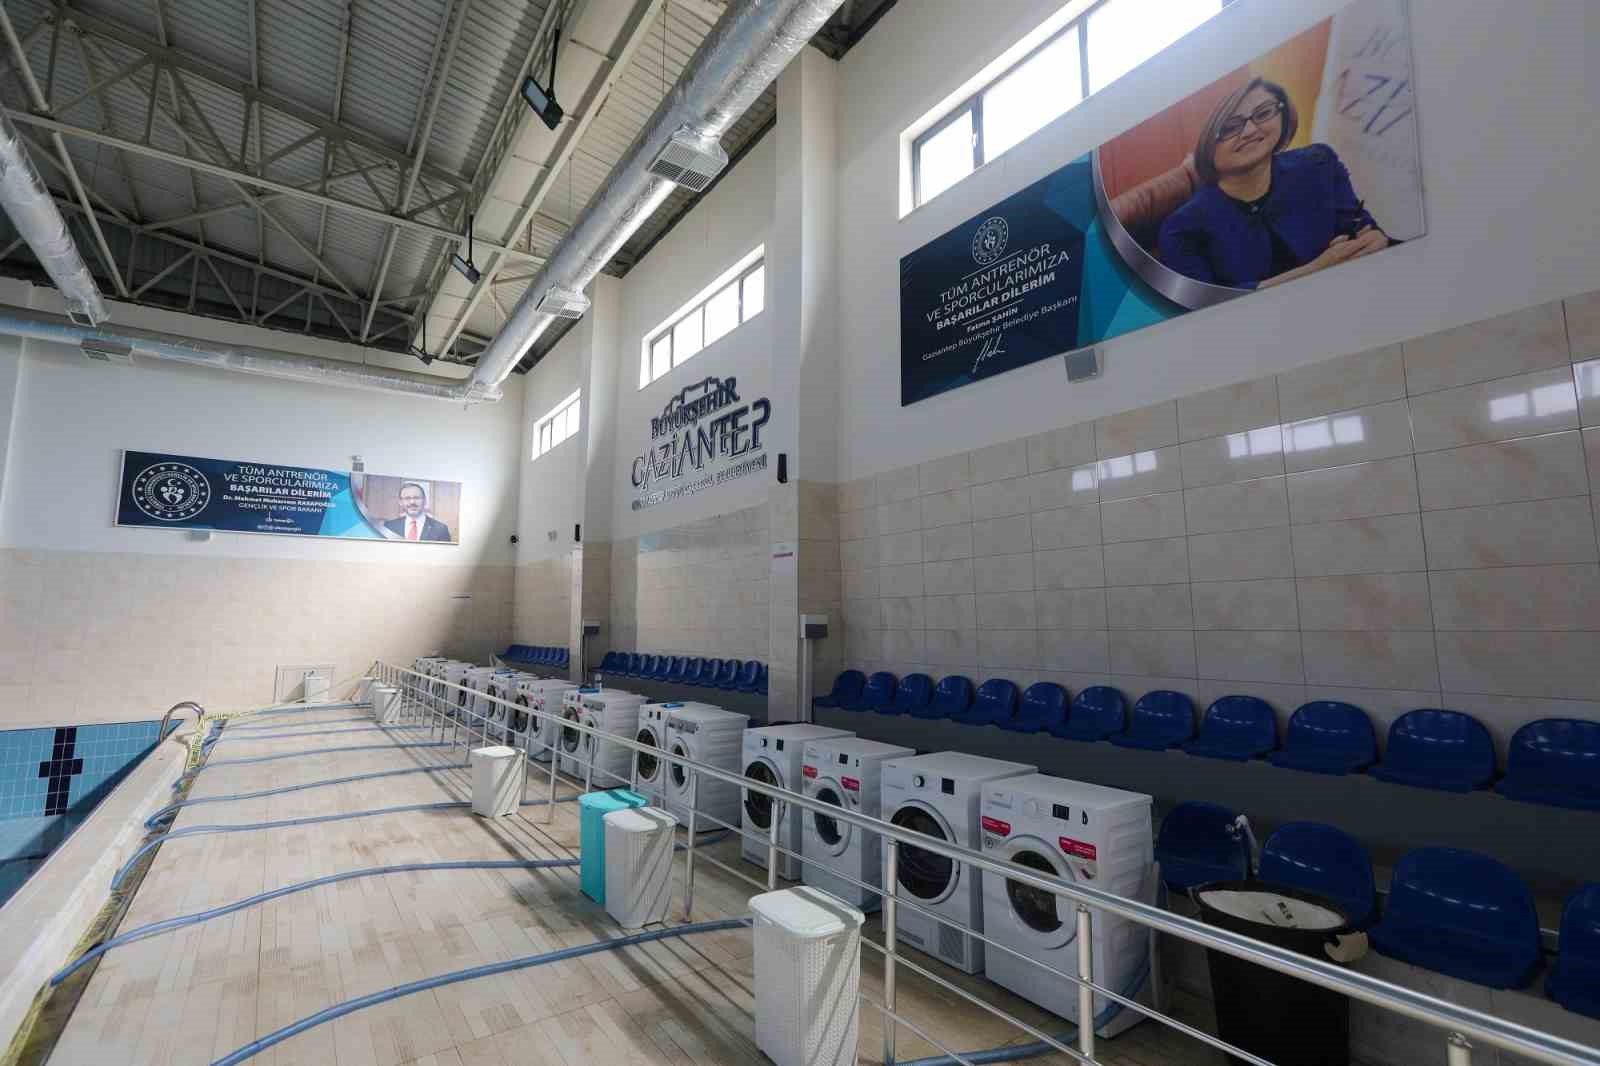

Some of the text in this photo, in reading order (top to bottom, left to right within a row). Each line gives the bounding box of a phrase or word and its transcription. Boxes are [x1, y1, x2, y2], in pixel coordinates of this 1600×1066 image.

[941, 243, 1050, 303] TÜM ANTRENÖR
[936, 272, 1055, 330] BAŞARILAR DİLERİM
[926, 308, 941, 322] VE
[223, 473, 339, 490] VE SPORCULARIMIZA
[240, 465, 328, 482] TÜM ANTRENÖR
[230, 484, 332, 499] BAŞARILAR DİLERİM
